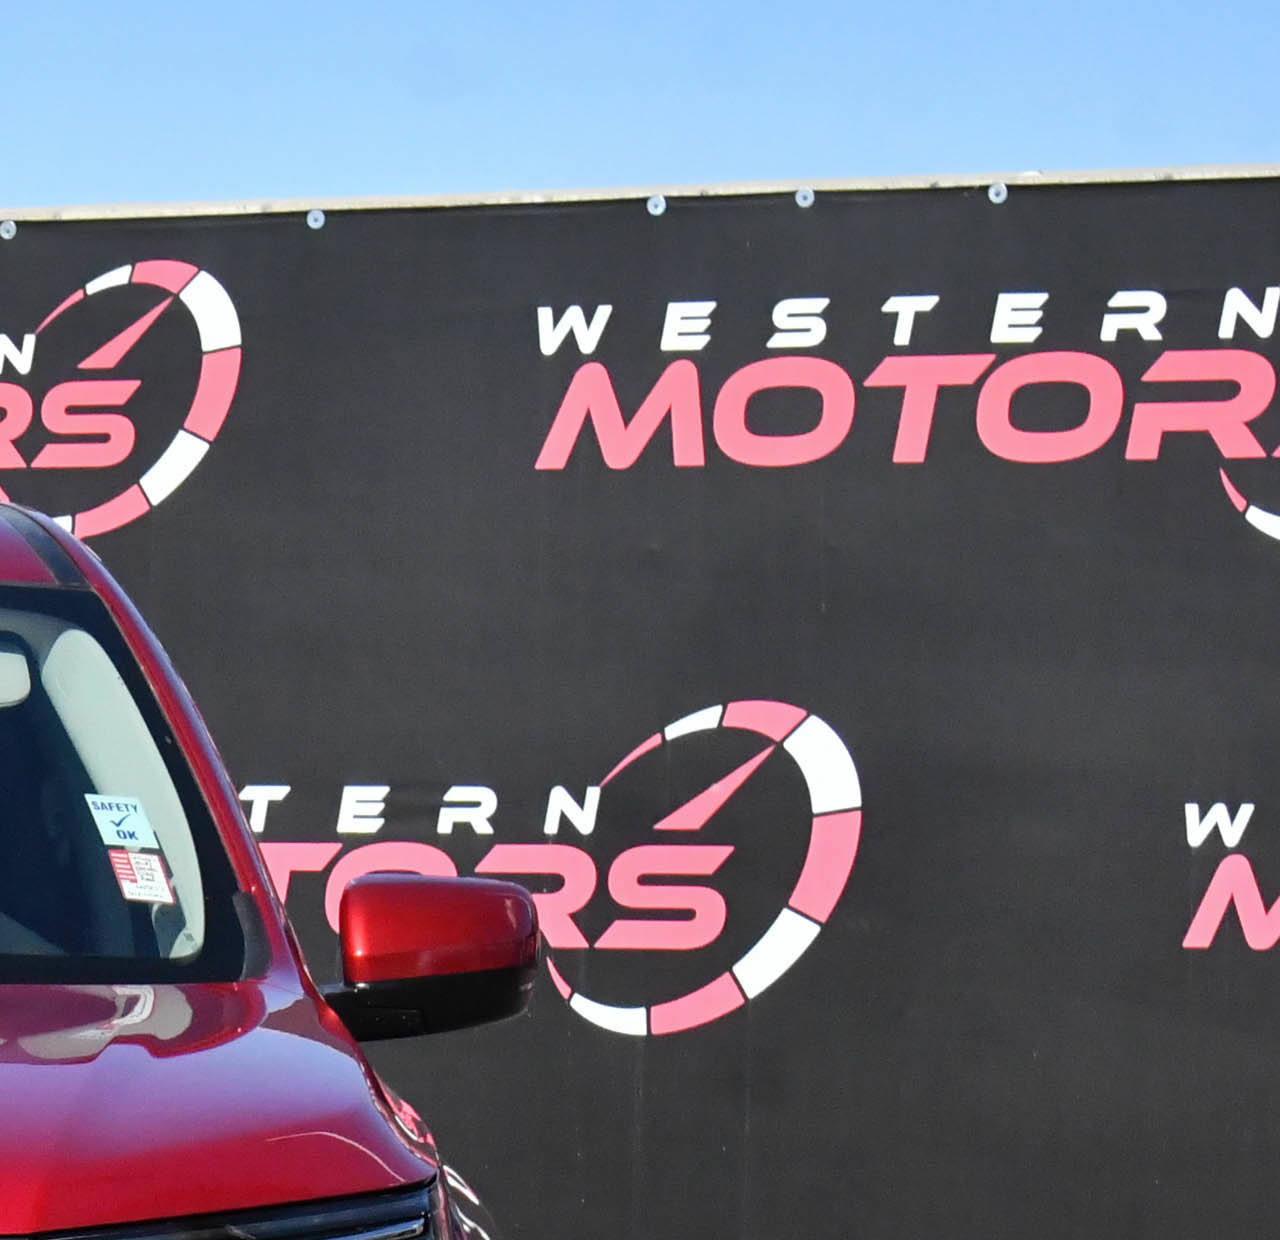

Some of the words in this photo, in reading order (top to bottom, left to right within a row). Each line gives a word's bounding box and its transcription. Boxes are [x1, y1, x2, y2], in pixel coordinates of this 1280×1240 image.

[537, 287, 1280, 356] WESTERN
[535, 349, 1280, 471] MOTOR
[91, 801, 138, 813] SAFETY
[1185, 803, 1255, 848] W
[116, 829, 139, 841] OK
